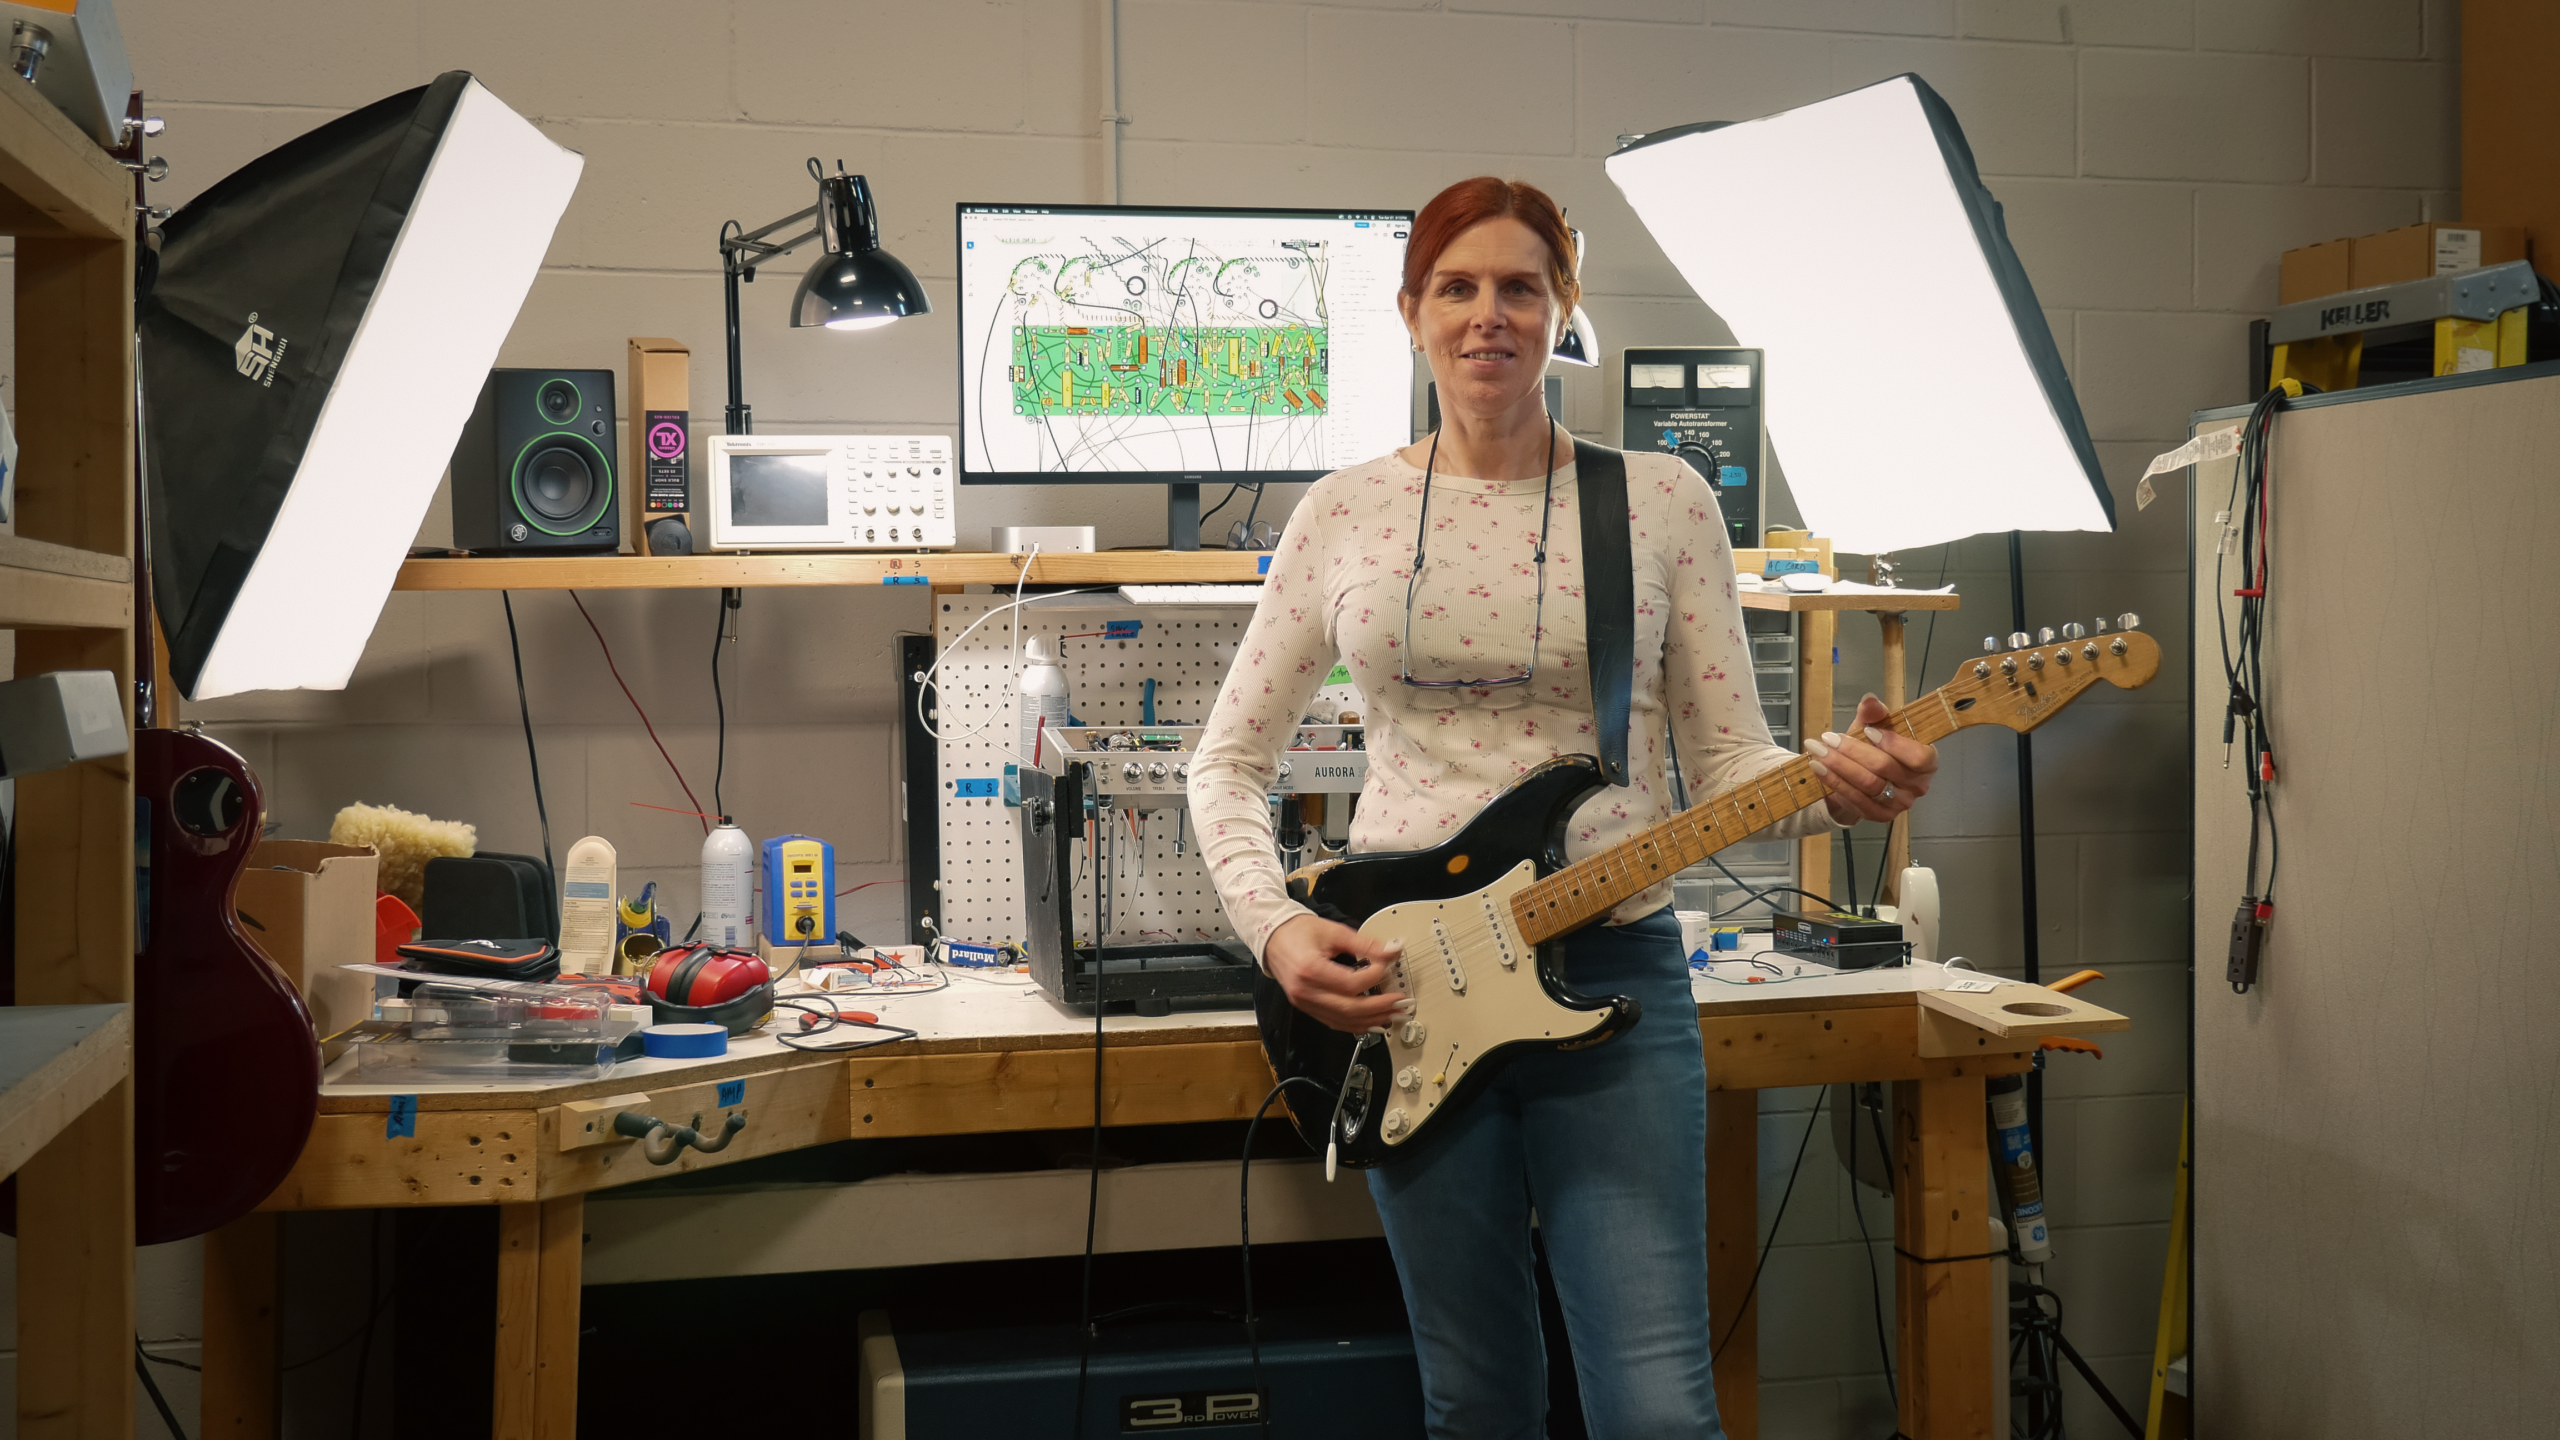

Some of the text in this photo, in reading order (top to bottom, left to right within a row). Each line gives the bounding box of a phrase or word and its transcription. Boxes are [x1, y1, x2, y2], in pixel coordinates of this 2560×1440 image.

[2321, 300, 2390, 331] KELLER
[263, 337, 288, 388] SHENGHUI
[656, 432, 677, 446] XL
[2060, 670, 2093, 695] STRATOCASTER
[2016, 692, 2056, 725] Fender
[1315, 767, 1355, 778] AURORA
[965, 782, 993, 793] R S
[952, 949, 995, 963] Mullard
[721, 1083, 741, 1103] AMP
[1130, 1393, 1259, 1426] 3RD POWER
